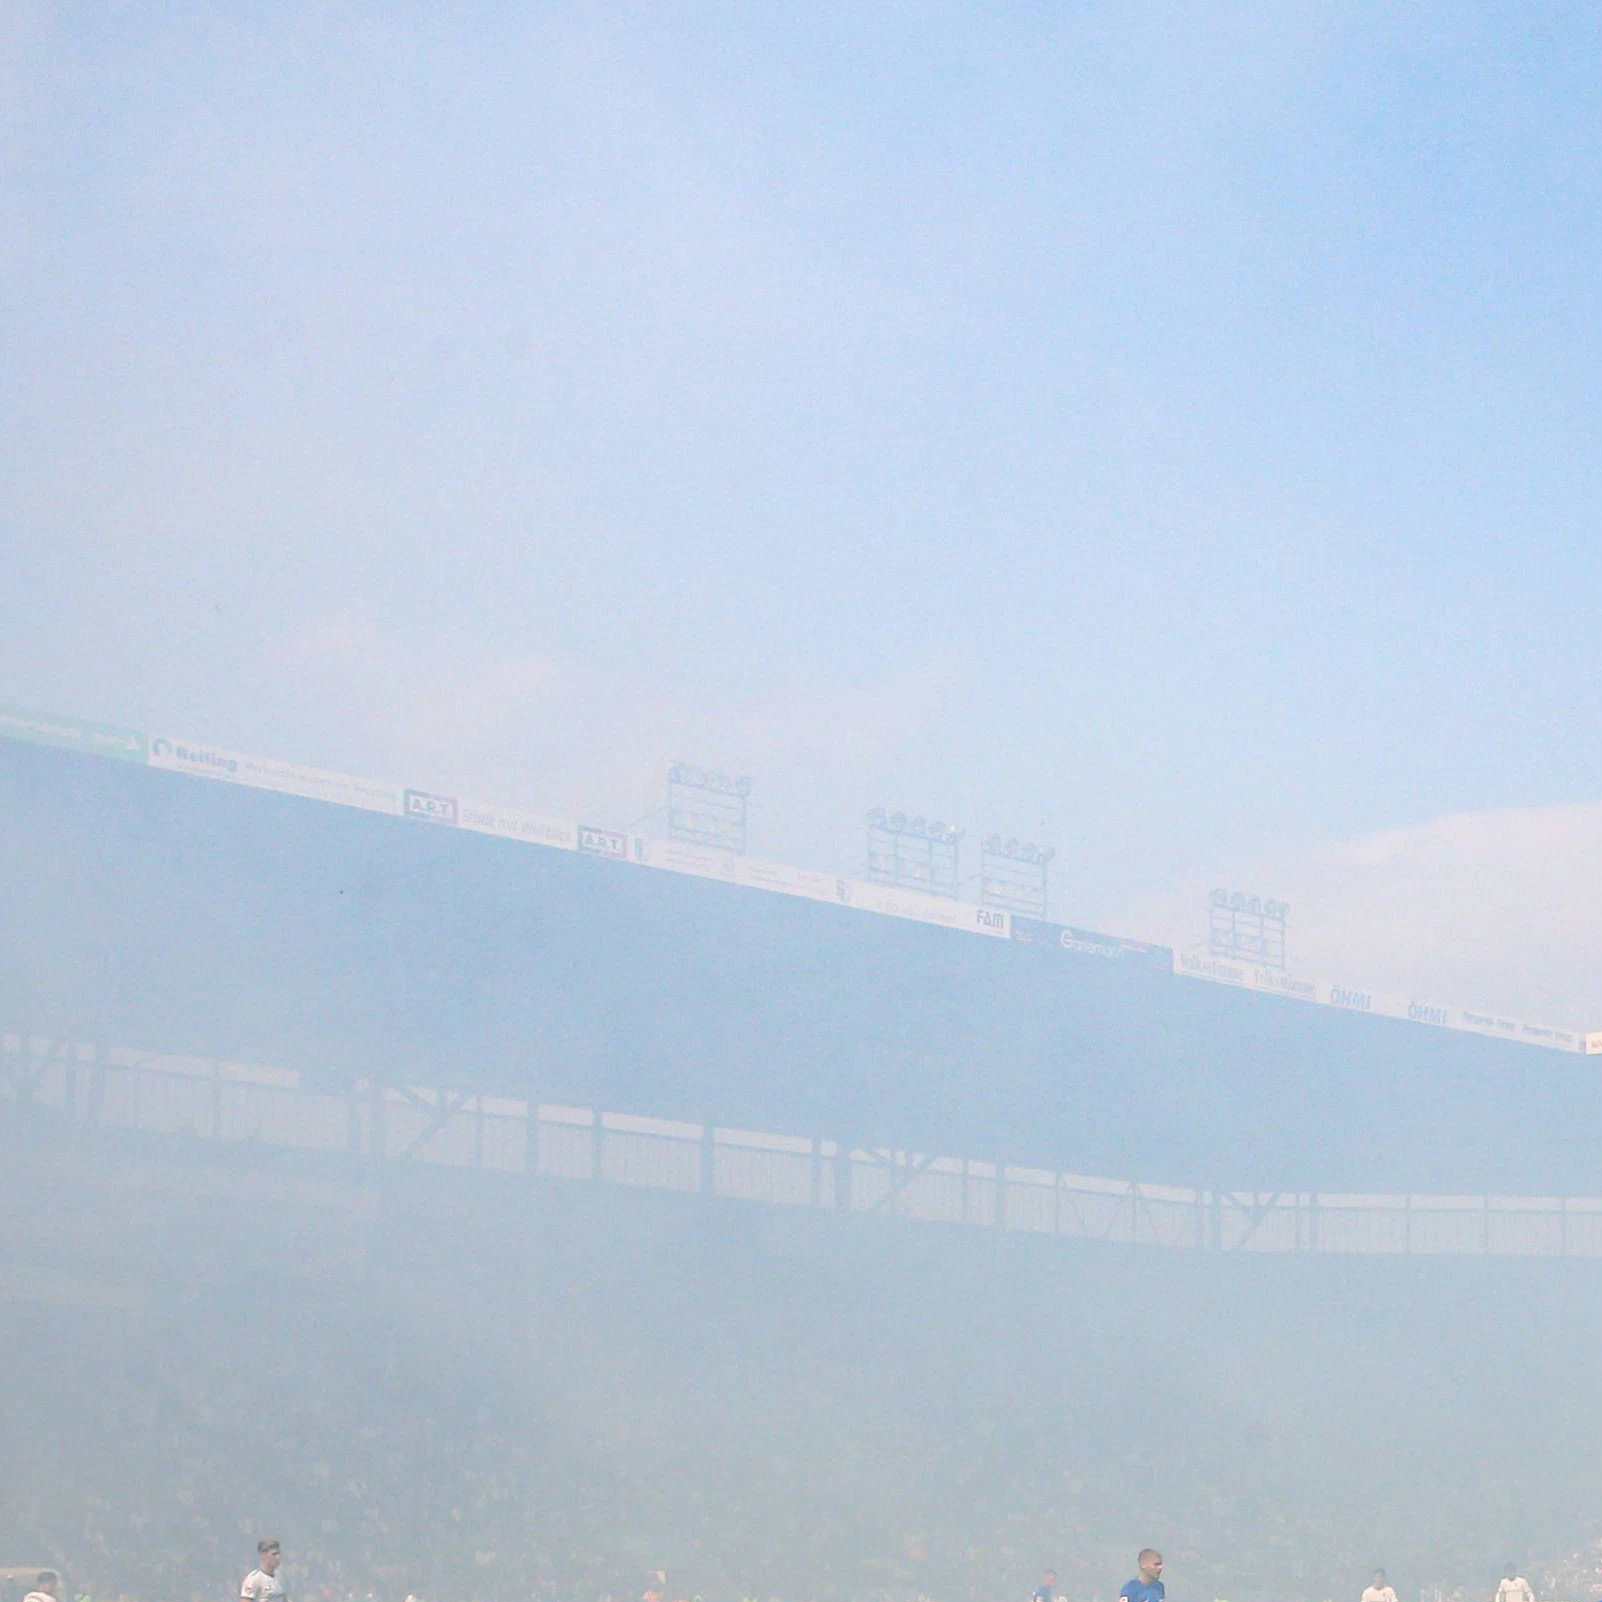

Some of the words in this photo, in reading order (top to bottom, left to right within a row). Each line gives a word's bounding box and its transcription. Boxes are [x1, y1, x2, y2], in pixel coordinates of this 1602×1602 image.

[176, 745, 239, 774] Reiling
[976, 909, 1005, 929] FAM
[1329, 984, 1372, 1010] ÖHMI
